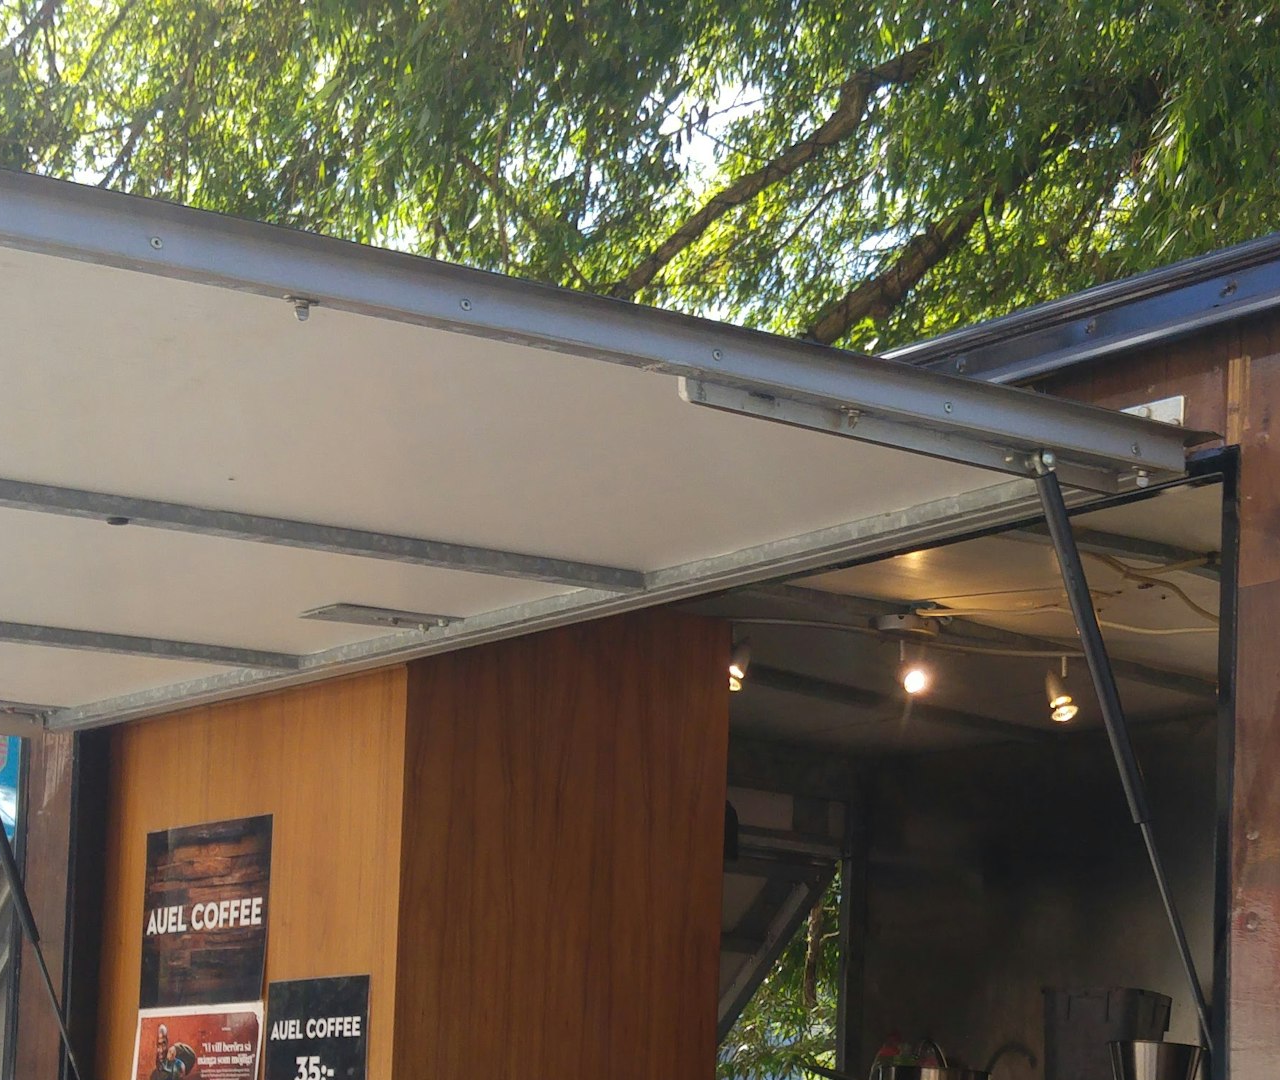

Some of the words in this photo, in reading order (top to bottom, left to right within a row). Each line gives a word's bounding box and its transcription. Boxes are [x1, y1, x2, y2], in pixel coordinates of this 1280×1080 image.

[146, 905, 187, 936] AUEL
[191, 897, 263, 931] COFFEE
[270, 1019, 303, 1041] AUEL
[306, 1016, 361, 1039] COFFEE
